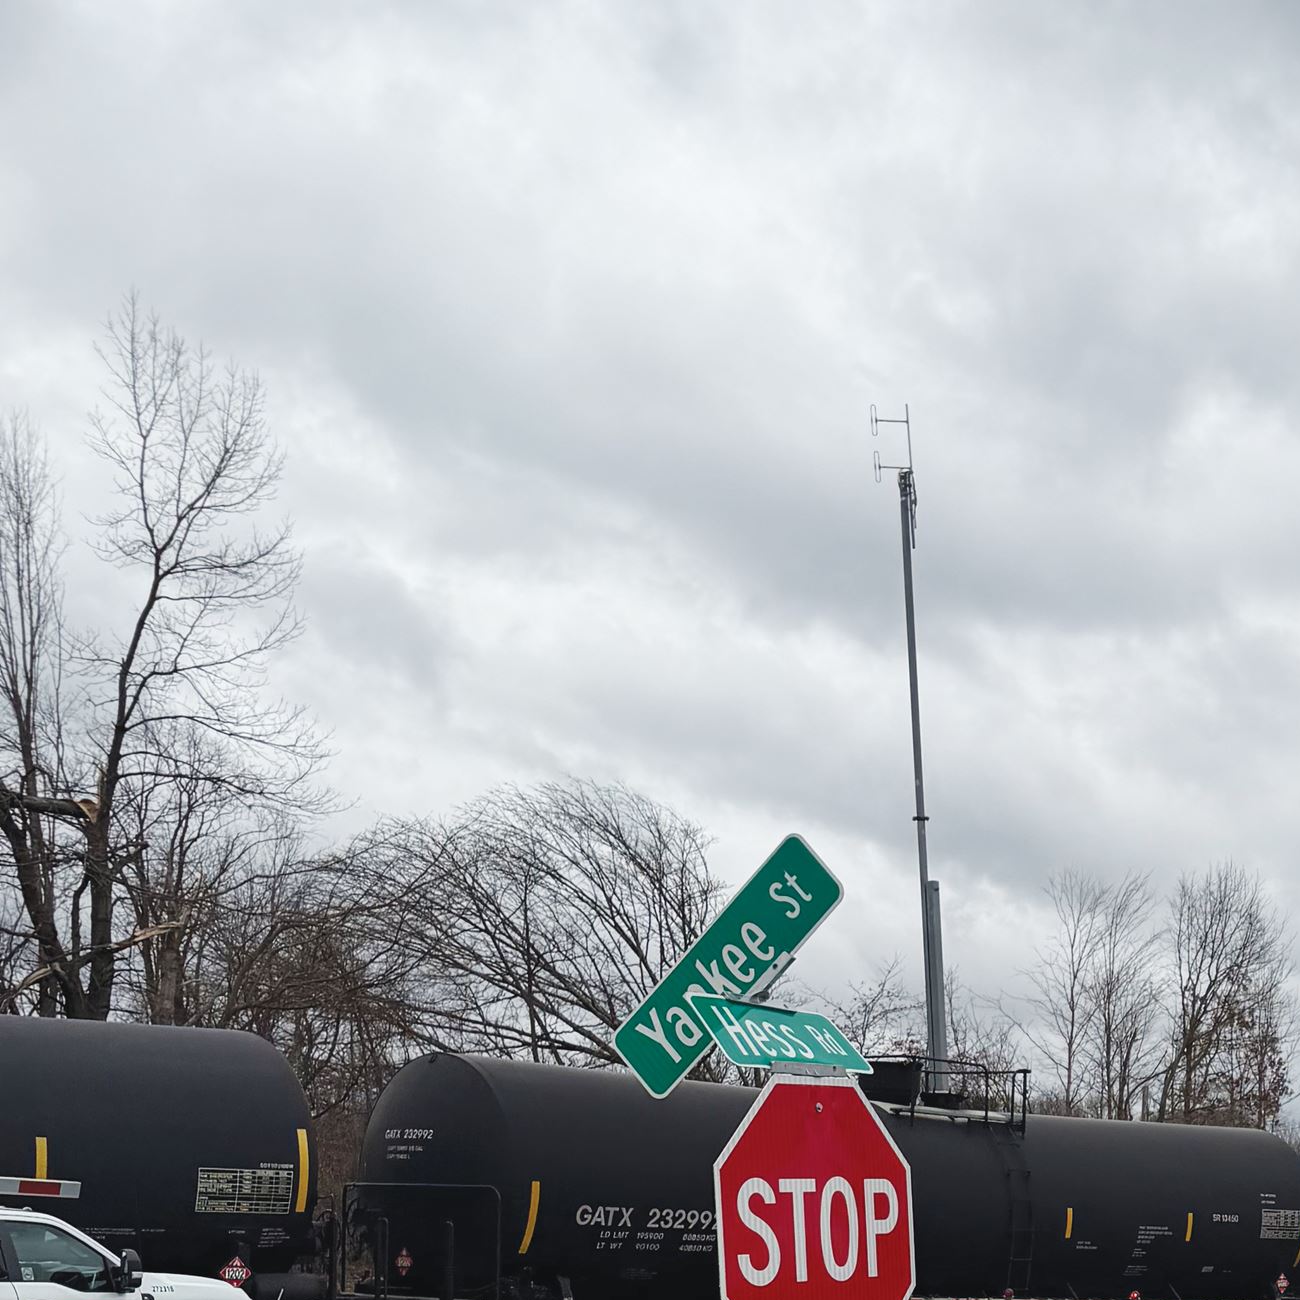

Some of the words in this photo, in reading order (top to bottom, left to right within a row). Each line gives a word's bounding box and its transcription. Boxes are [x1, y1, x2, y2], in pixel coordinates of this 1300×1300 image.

[768, 870, 813, 919] St
[710, 1005, 815, 1060] Hess
[804, 1024, 848, 1057] Rd
[575, 1204, 634, 1228] GATX
[599, 1230, 611, 1239] LD
[612, 1231, 630, 1240] LMT
[736, 1175, 900, 1288] STOP
